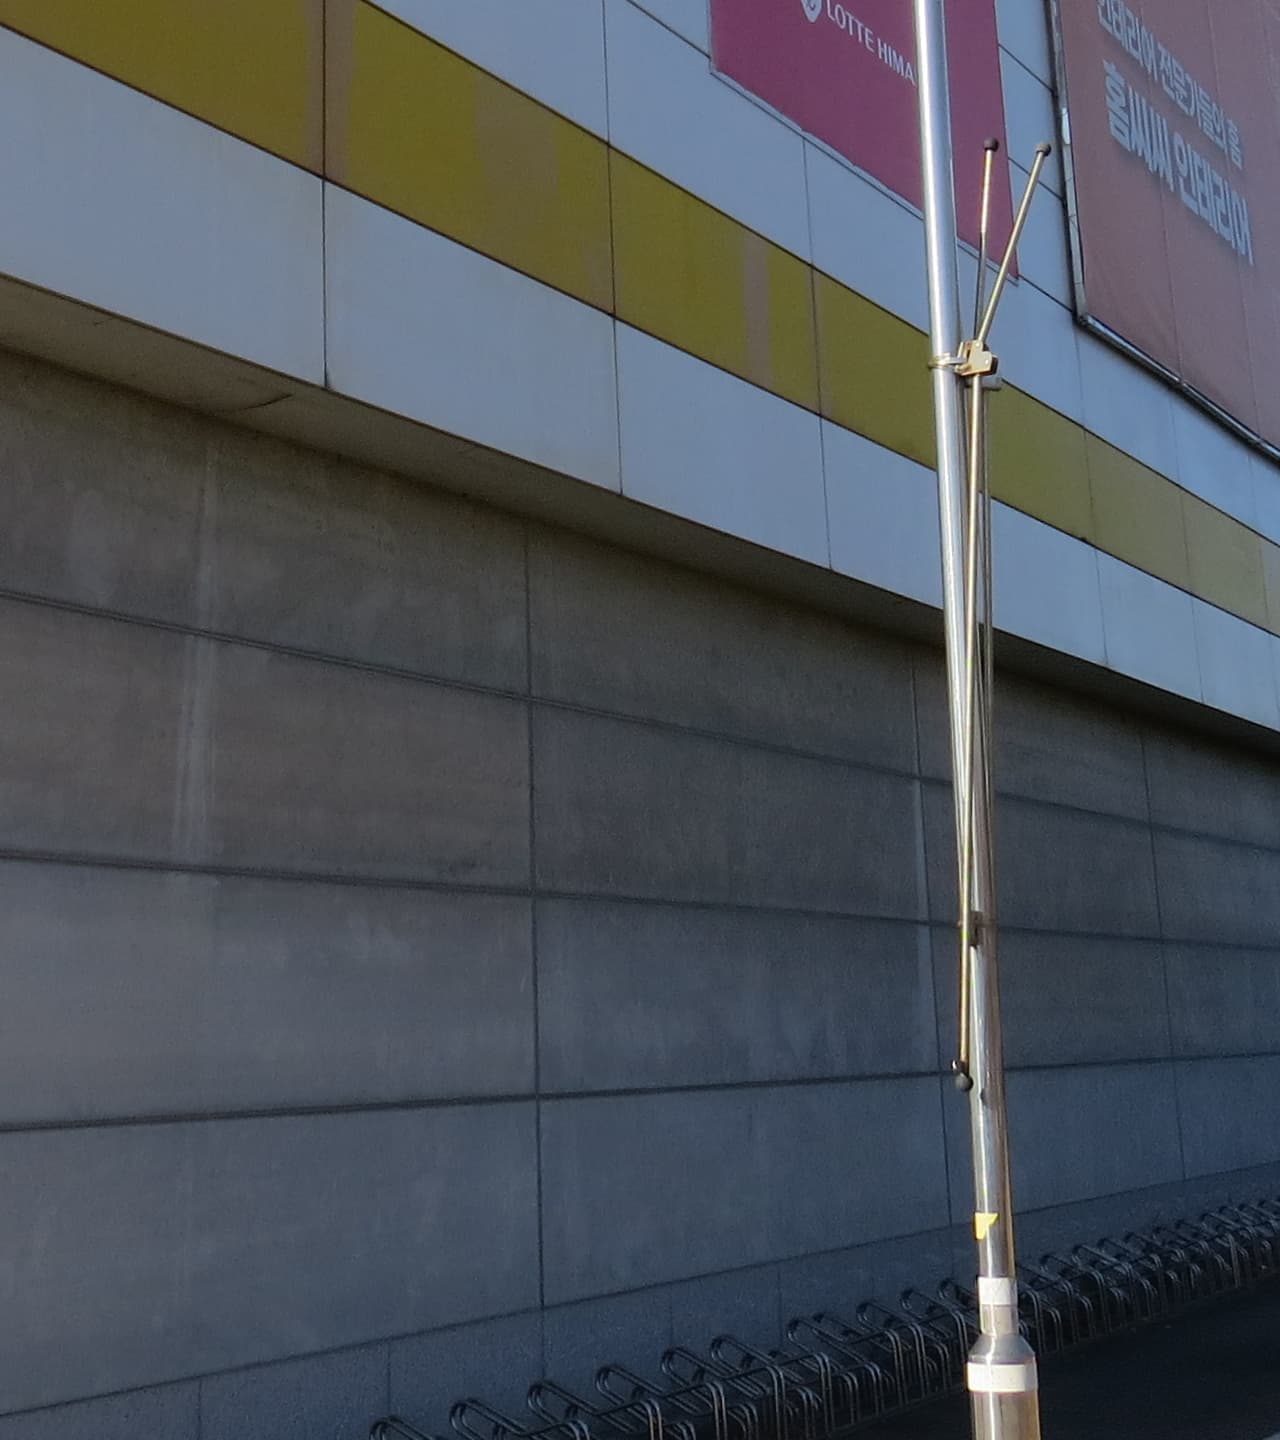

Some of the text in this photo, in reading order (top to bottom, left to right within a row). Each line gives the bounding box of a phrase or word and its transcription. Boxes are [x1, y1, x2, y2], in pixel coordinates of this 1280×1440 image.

[876, 37, 916, 87] HIMA
[1156, 40, 1229, 154] 전문가들의
[1227, 118, 1243, 171] 홈
[1103, 59, 1255, 266] 홈씨씨 인테리어
